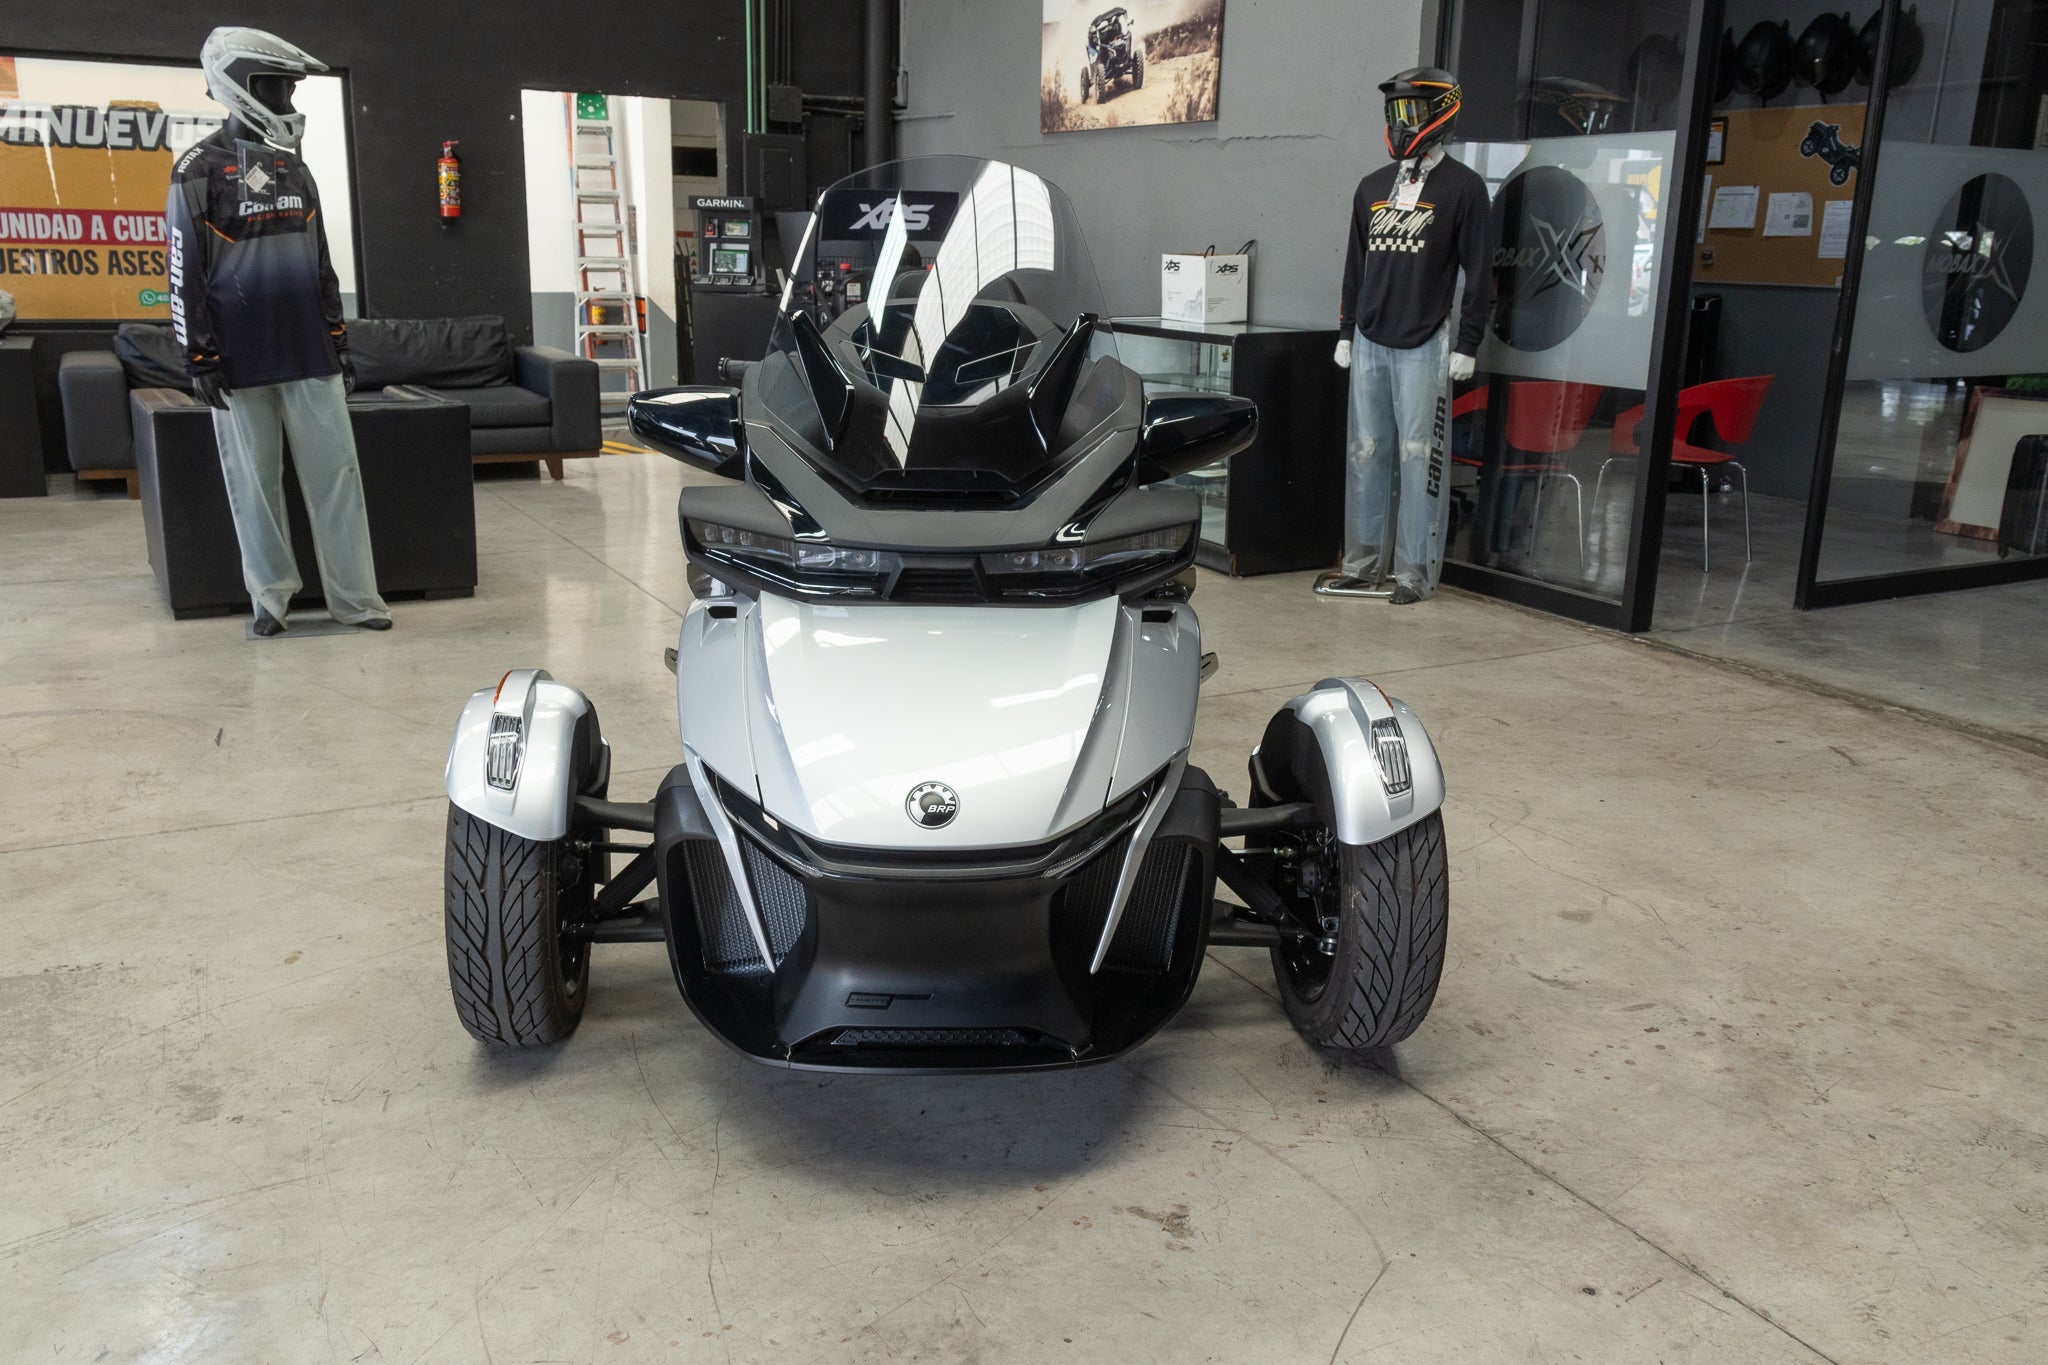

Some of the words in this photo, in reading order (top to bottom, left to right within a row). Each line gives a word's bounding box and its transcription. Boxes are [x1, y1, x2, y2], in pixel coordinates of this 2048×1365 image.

[177, 146, 204, 173] ROTAX
[697, 198, 742, 208] GARMIN
[91, 214, 107, 240] A
[108, 250, 168, 276] ASES
[1164, 259, 1180, 271] XPS
[1215, 263, 1239, 274] XPS
[928, 804, 956, 813] BRP
